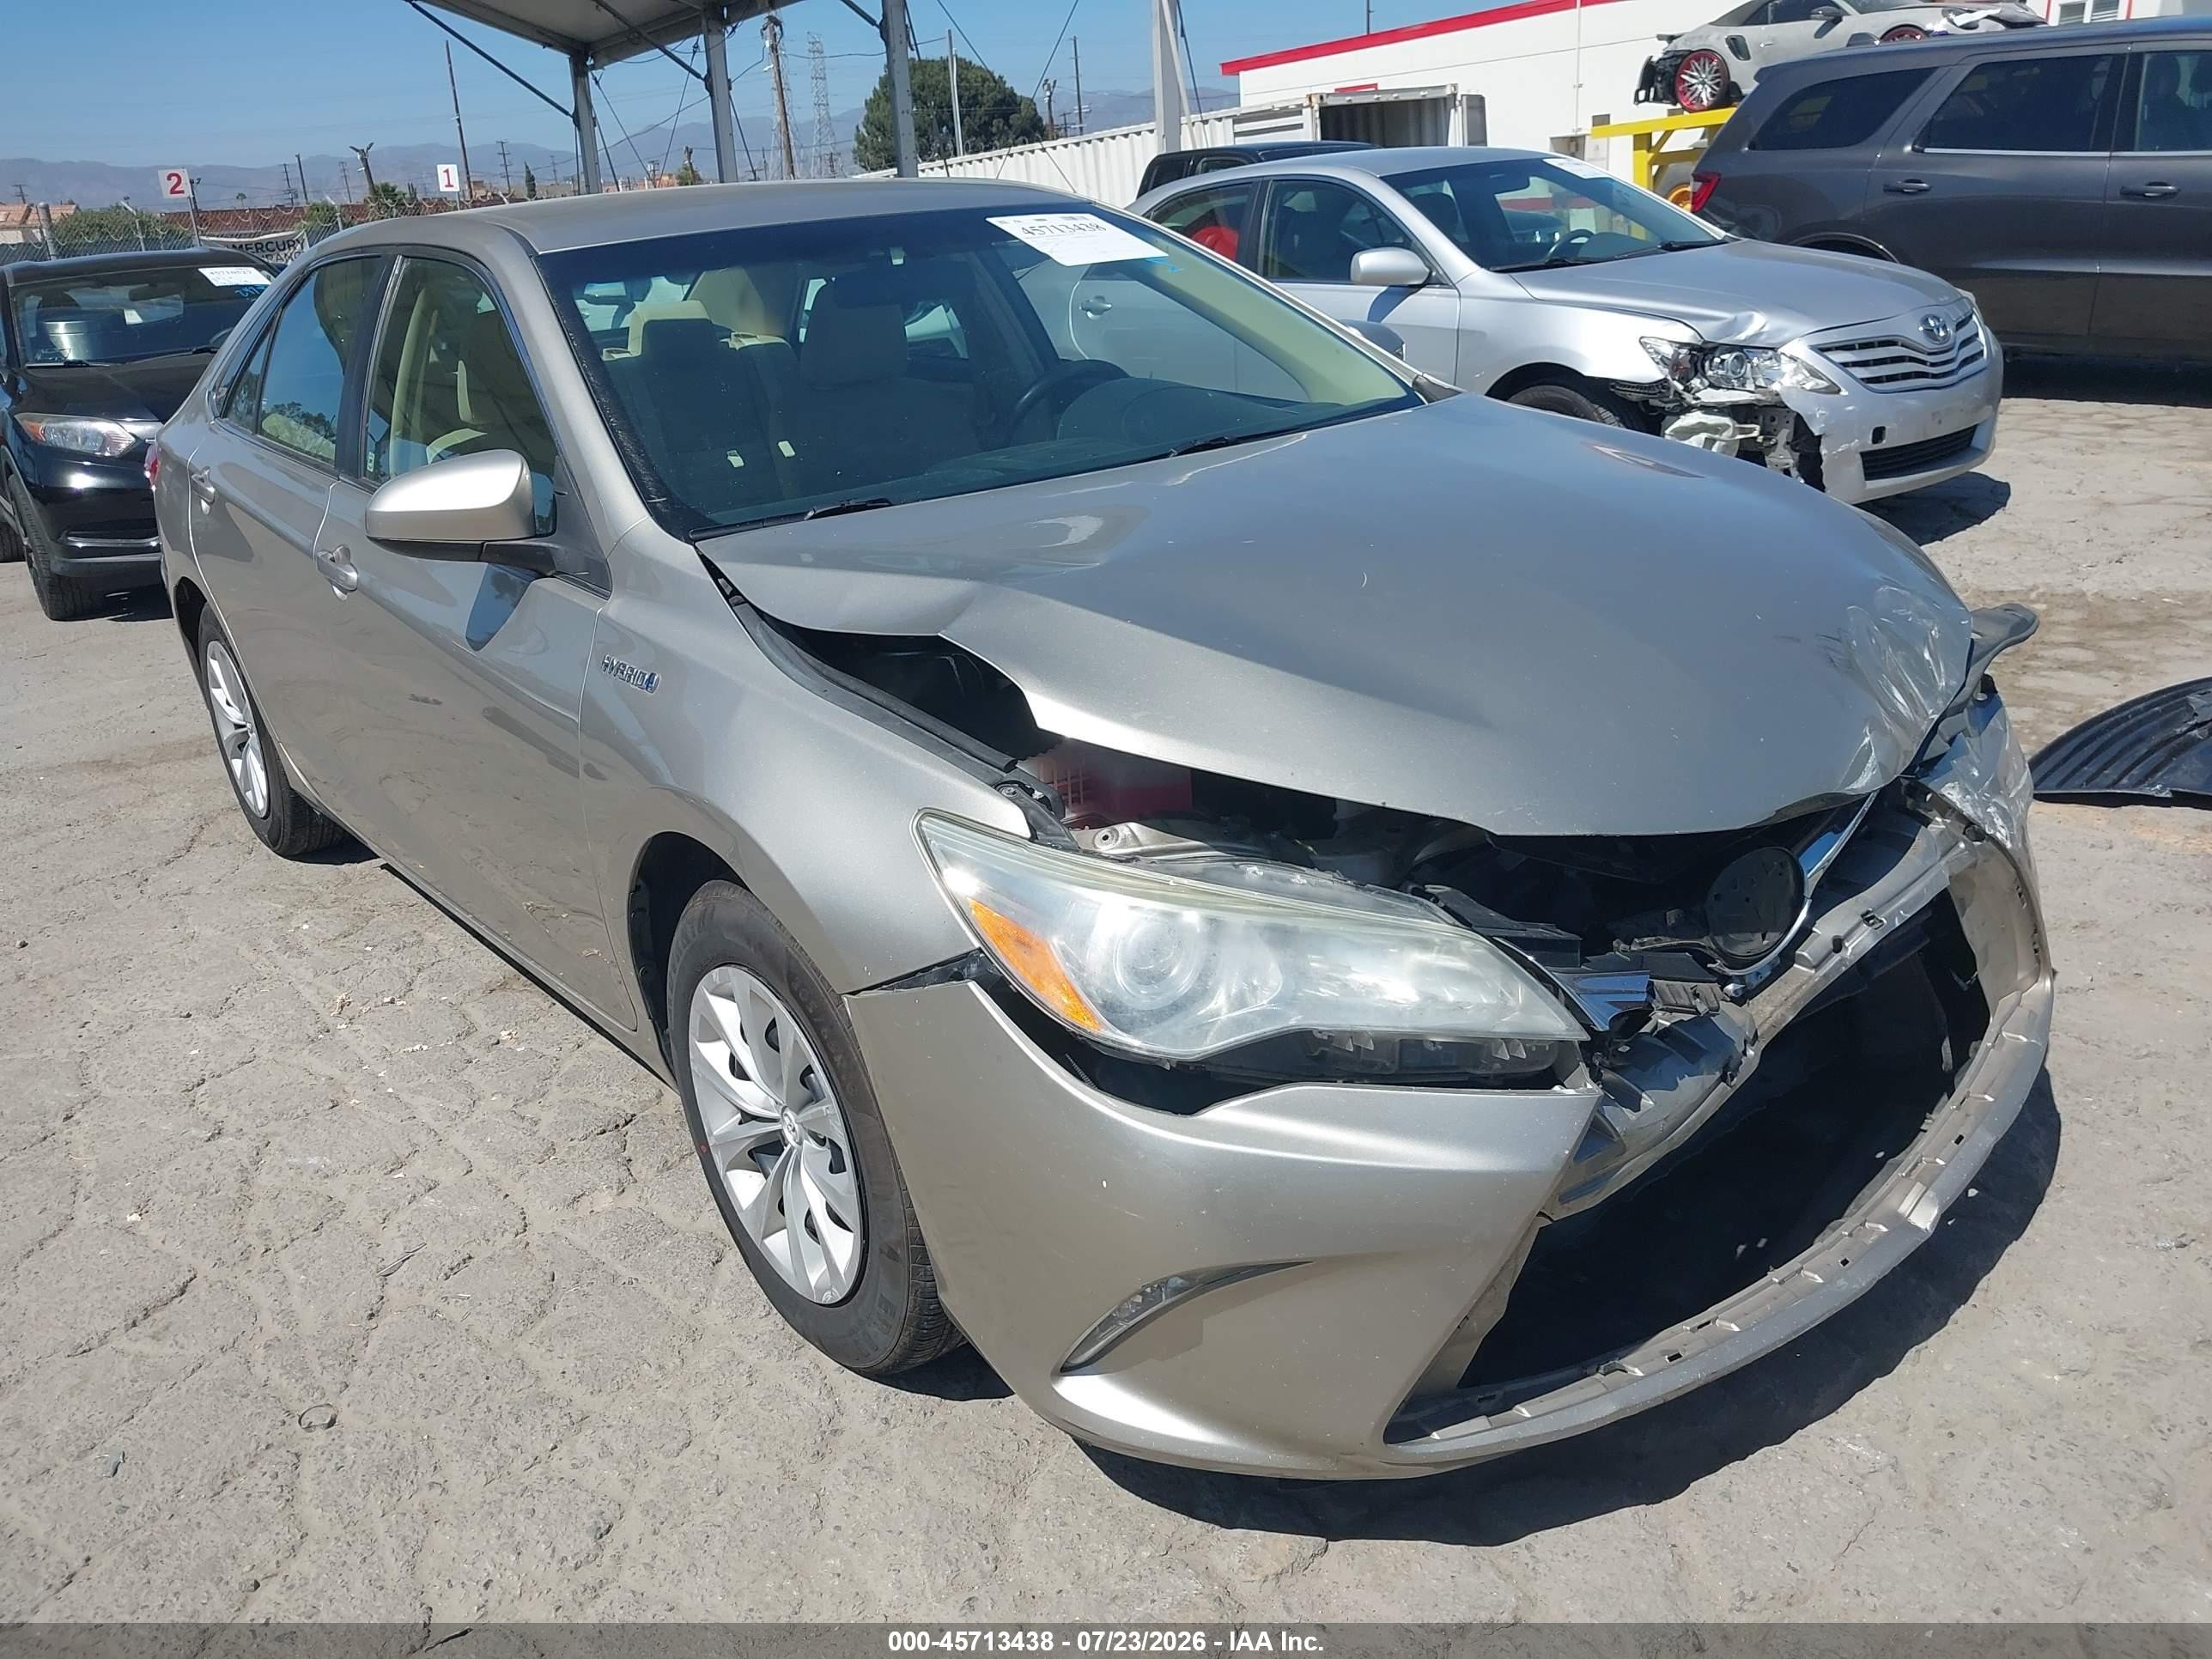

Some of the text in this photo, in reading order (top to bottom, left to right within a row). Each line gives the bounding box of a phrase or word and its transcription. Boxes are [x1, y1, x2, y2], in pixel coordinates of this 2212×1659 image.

[167, 173, 185, 195] 2
[443, 168, 454, 188] 1
[1021, 222, 1108, 236] 45713438
[601, 653, 647, 690] HYBRID
